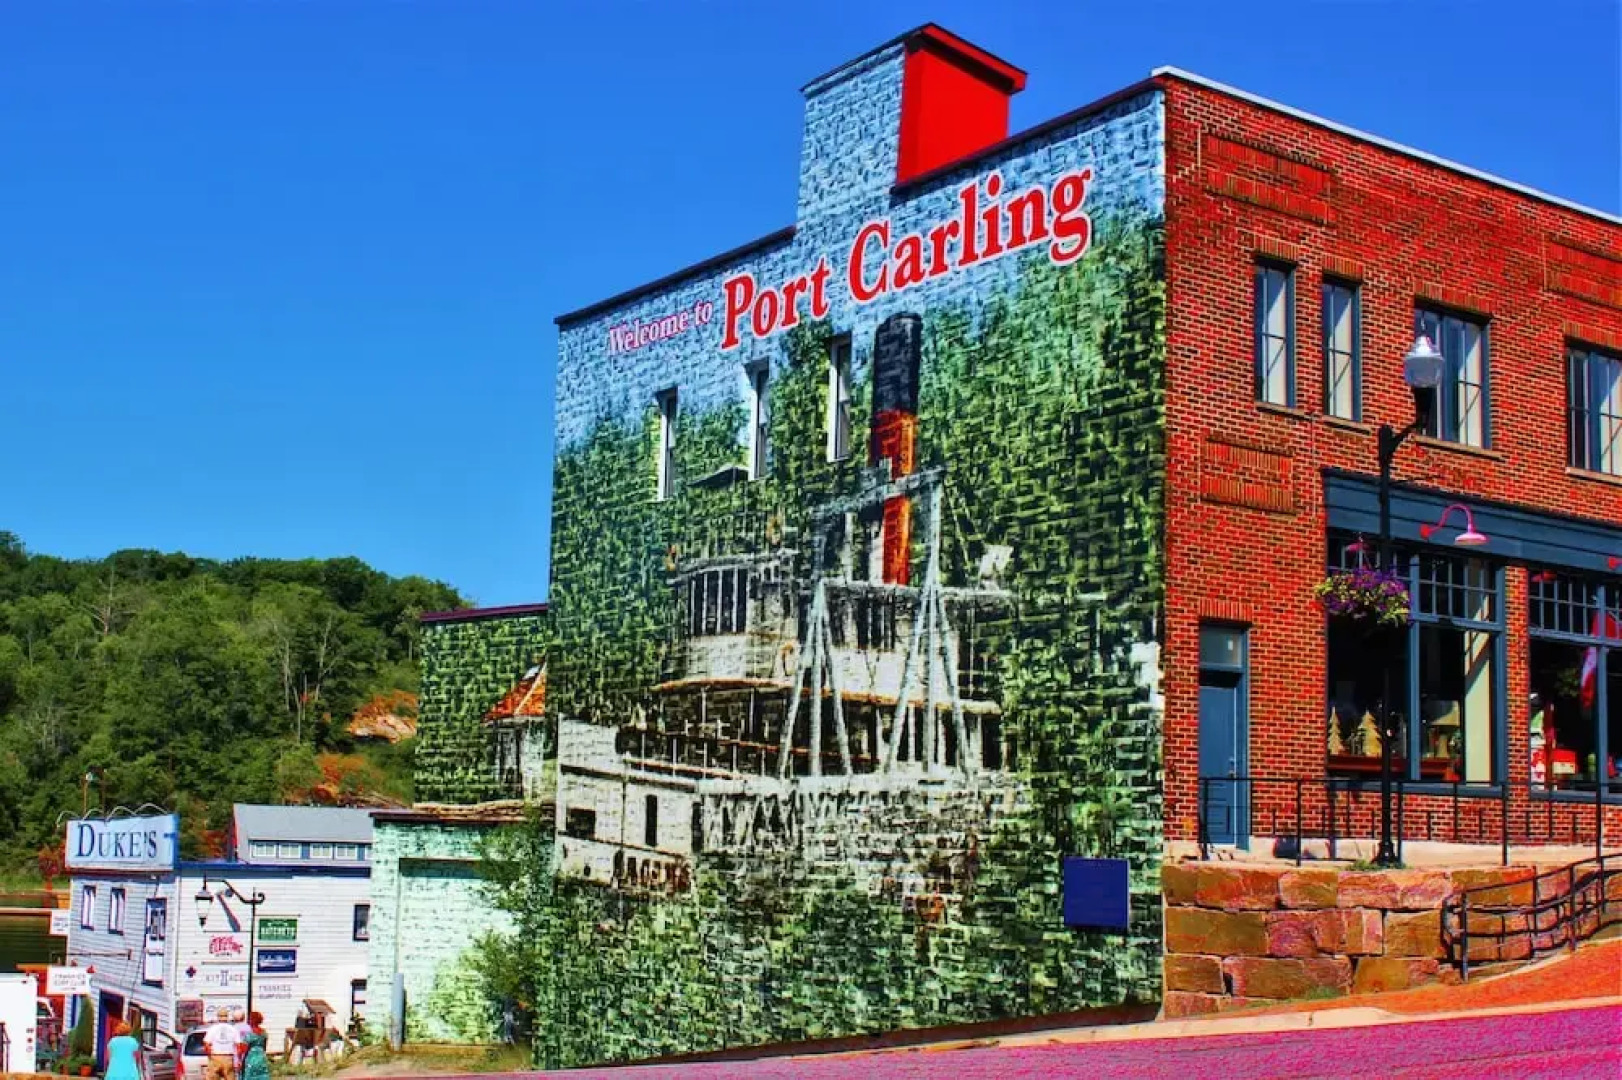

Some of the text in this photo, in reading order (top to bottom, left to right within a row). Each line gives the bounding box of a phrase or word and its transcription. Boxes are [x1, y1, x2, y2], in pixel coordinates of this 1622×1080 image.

[609, 168, 1092, 356] Welcome to Port Carling
